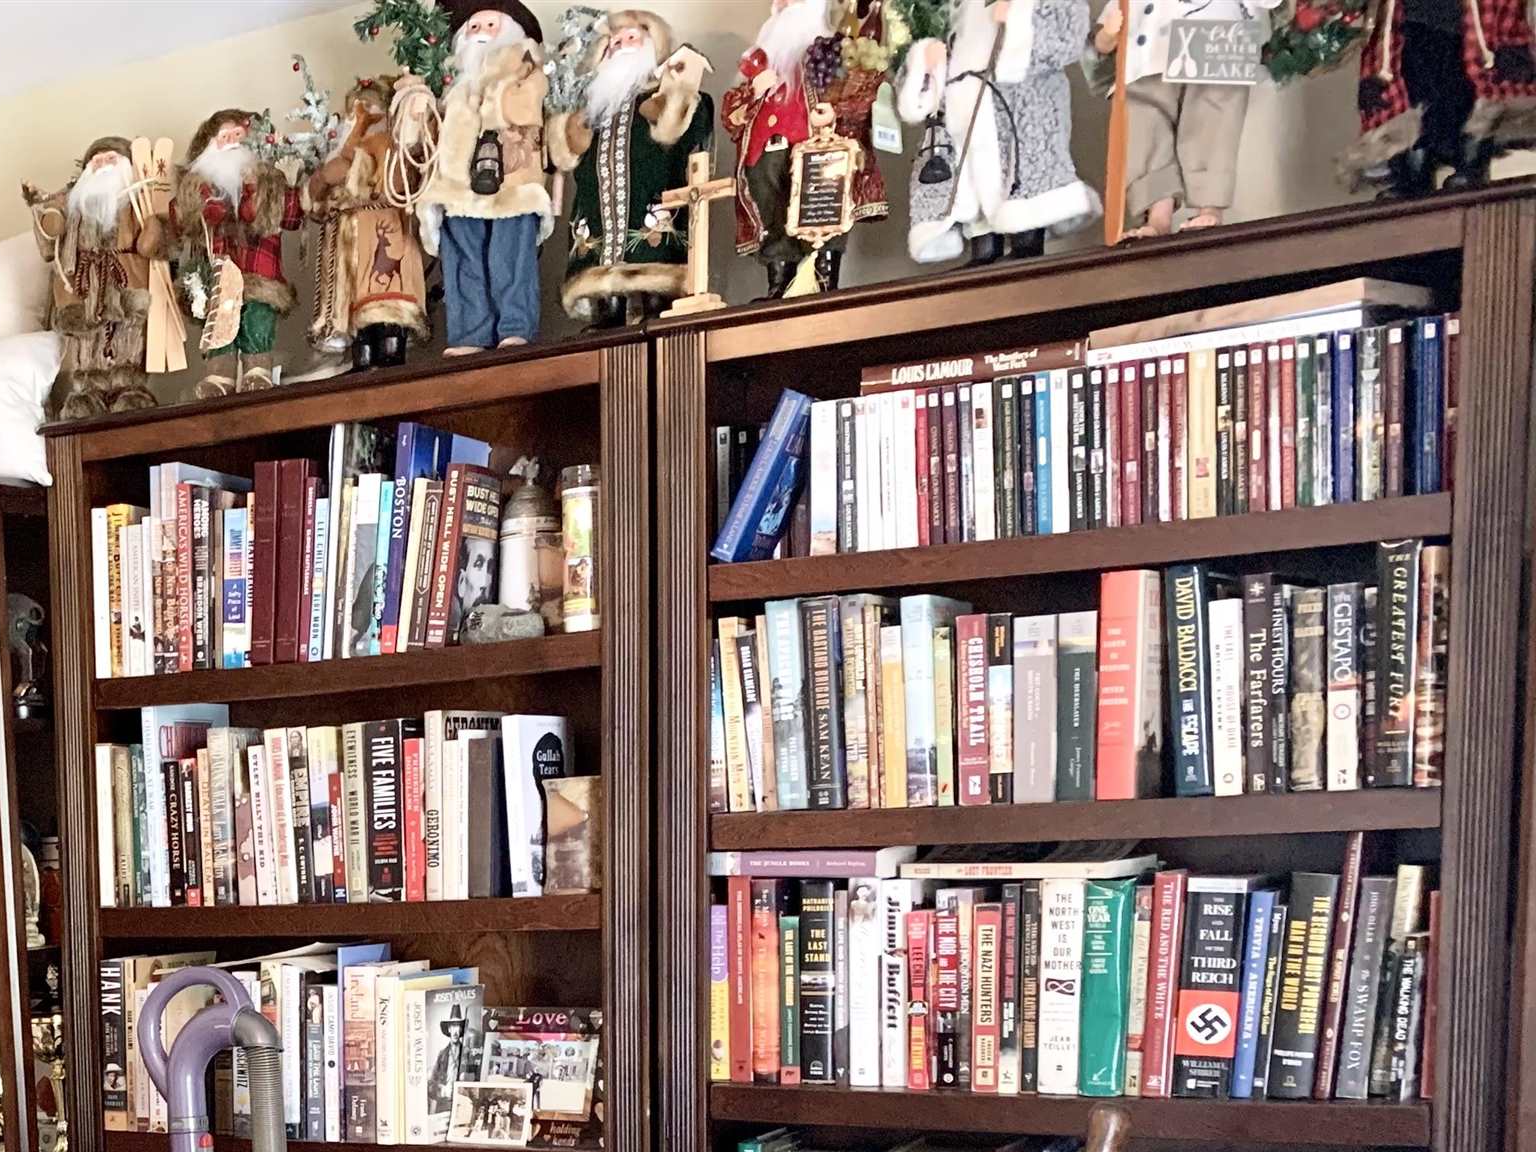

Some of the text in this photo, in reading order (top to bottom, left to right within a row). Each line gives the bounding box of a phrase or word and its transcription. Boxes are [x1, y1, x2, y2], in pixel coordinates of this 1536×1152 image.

[1203, 62, 1256, 78] LAKE
[891, 365, 924, 385] LOUIS
[391, 476, 407, 539] BOSTON
[466, 499, 487, 514] WIDE
[467, 485, 490, 500] BUST
[435, 470, 459, 608] BUST HELL WIDE OPEN
[177, 489, 189, 631] AMERICA'S WILD HORSES
[811, 609, 828, 626] THE
[1271, 608, 1285, 695] FINEST HOURS
[1333, 603, 1353, 682] GESTAPO
[1388, 567, 1407, 721] GREATEST FURY
[1174, 576, 1199, 756] DAVID BALDACCI ESCAPE
[968, 637, 984, 746] CHISHOLM TRAIL
[1249, 629, 1267, 748] The Farfarers
[818, 714, 829, 742] SAM
[346, 730, 358, 779] EYEWITNESS
[371, 736, 395, 766] FIVE
[536, 748, 561, 765] Gullah
[819, 745, 831, 780] KEAN
[538, 763, 560, 776] Tears
[348, 790, 359, 816] WORLD
[373, 769, 396, 830] FAMILIES
[169, 793, 181, 869] CRAZY HORSE
[349, 820, 360, 836] WAR
[426, 809, 439, 868] GERONIMO
[258, 850, 267, 868] KID
[1056, 894, 1072, 903] THE
[1202, 904, 1233, 916] RISE
[1312, 897, 1330, 913] THE
[807, 941, 828, 950] LAST
[939, 917, 958, 955] THE MOB
[1199, 930, 1233, 941] FALL
[1289, 921, 1307, 942] MAN
[711, 944, 724, 974] Help
[804, 953, 832, 962] STAND
[885, 896, 901, 1029] Jimmy Buffett
[911, 946, 926, 988] LEE CHILD
[1154, 882, 1173, 1019] THE RED AND THE WHITE
[1191, 957, 1237, 969] THIRD
[1285, 958, 1302, 975] THE
[100, 967, 121, 1015] HANK
[940, 969, 958, 1008] THE CITY
[980, 928, 993, 1023] THE NAZI HUNTERS
[1191, 972, 1233, 984] REICH
[1243, 917, 1264, 1039] TRIVIA AMERICANA
[1281, 977, 1300, 1010] WORLD
[1298, 985, 1320, 1034] POWERFUL
[1394, 959, 1415, 1040] THE WALKING DEAD
[516, 1007, 569, 1026] Love
[1347, 984, 1369, 1070] SWAMP FOX
